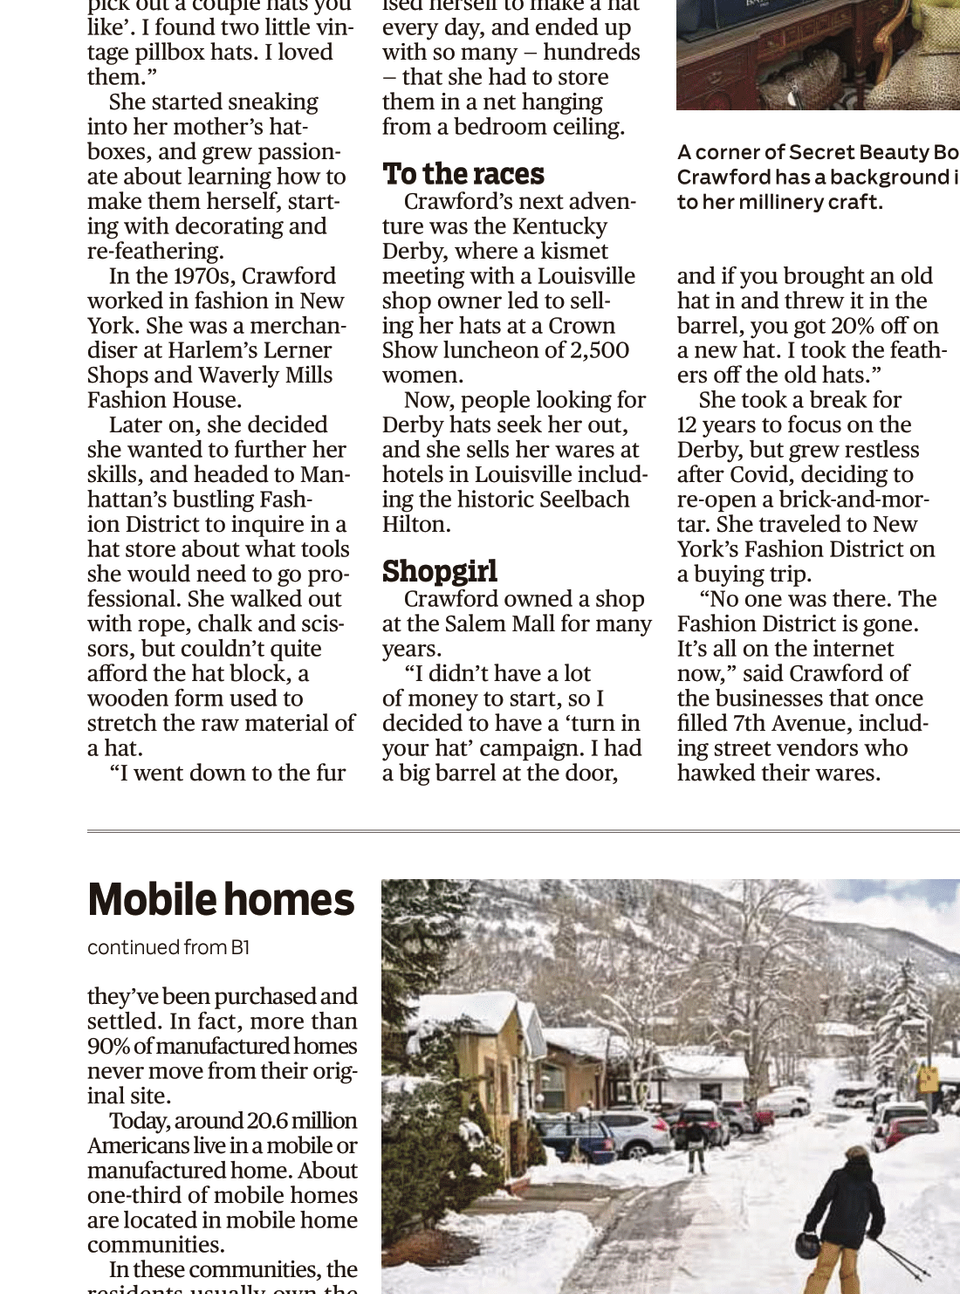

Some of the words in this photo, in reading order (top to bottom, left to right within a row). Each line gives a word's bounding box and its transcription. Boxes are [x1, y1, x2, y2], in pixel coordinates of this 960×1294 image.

[383, 162, 416, 184] To
[422, 161, 467, 184] the
[474, 167, 544, 185] races
[677, 195, 698, 209] to
[703, 194, 735, 209] her
[740, 194, 824, 212] millinery
[829, 193, 882, 209] craft.
[383, 514, 450, 532] Hilton.
[88, 539, 119, 557] hat
[126, 542, 175, 557] store
[182, 539, 240, 557] about
[245, 539, 295, 557] what
[301, 539, 349, 557] tools
[383, 559, 498, 587] Shopgirl
[678, 763, 755, 781] hawked
[762, 763, 810, 781] their
[815, 768, 880, 781] wares.
[90, 881, 216, 916] Mobile
[225, 881, 354, 916] homes
[88, 939, 179, 955] continued
[184, 939, 226, 955] from
[232, 940, 248, 954] B1
